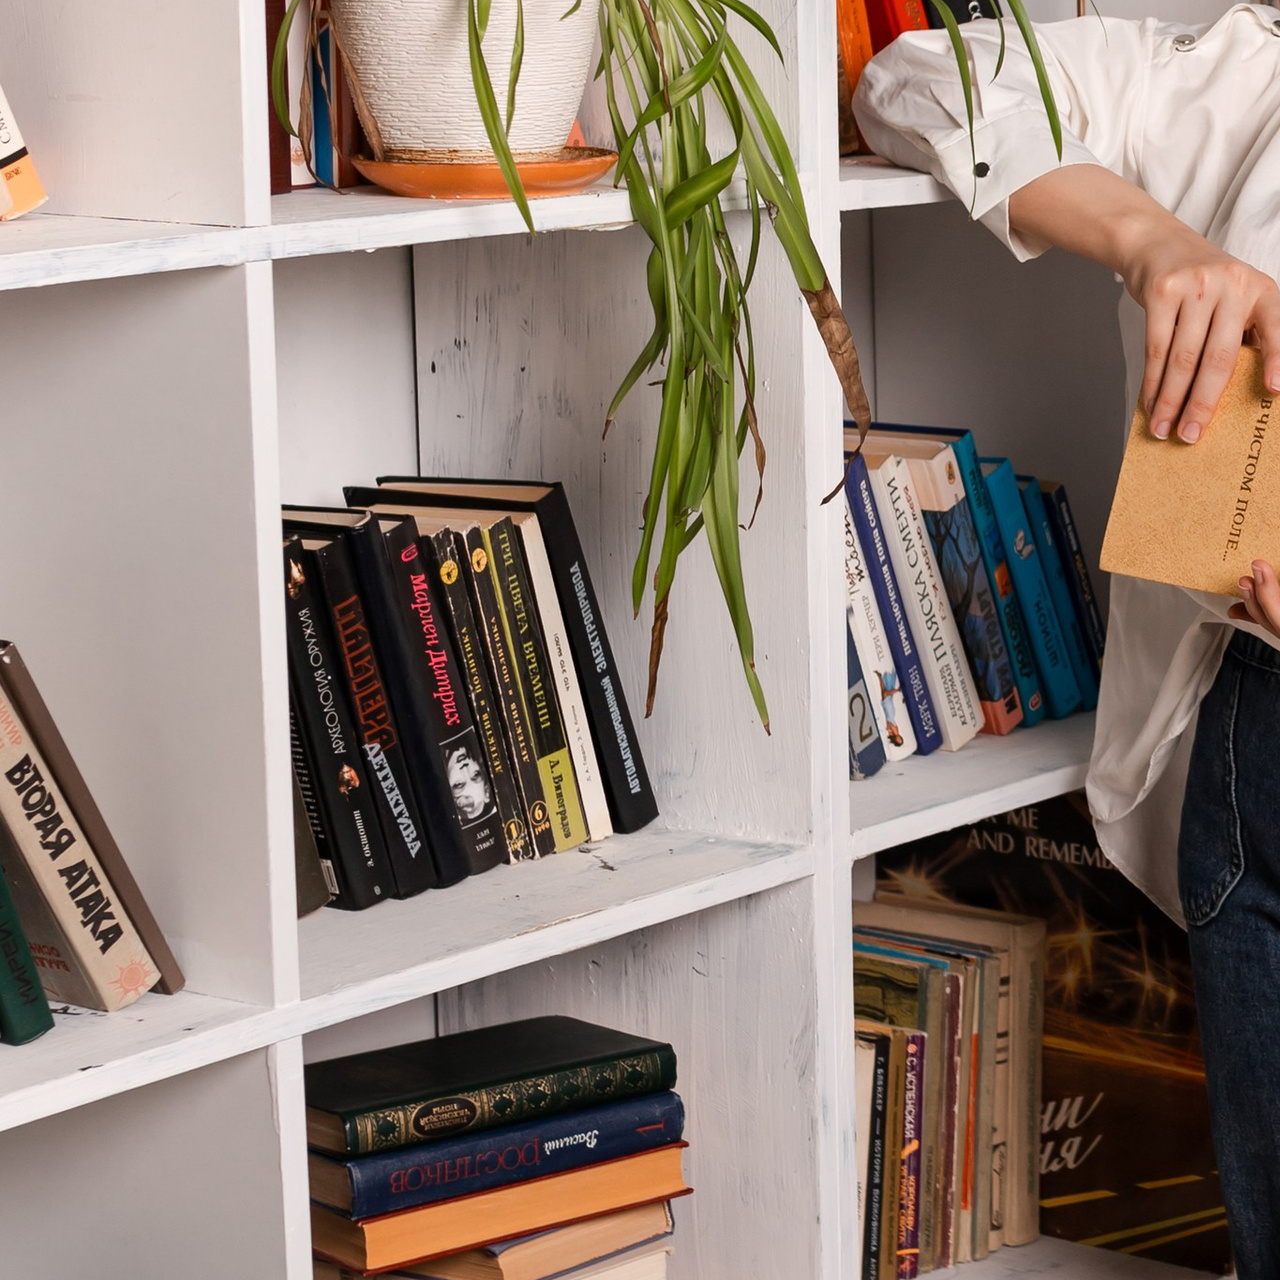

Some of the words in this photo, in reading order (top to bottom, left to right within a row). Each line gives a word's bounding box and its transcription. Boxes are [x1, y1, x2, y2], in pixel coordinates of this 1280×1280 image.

[1261, 398, 1272, 410] В
[1240, 413, 1270, 493] ЧИСТОМ
[887, 477, 919, 569] СМЕРТИ
[298, 607, 323, 667] ОРУЖИЯ
[409, 573, 440, 651] Марлен
[428, 647, 461, 727] Дитрих
[490, 615, 510, 683] ПОЛИТИКА
[498, 529, 514, 567] ТРИ
[508, 572, 529, 636] ЦВЕТА
[523, 639, 551, 731] ВРЕМЕНИ
[914, 570, 947, 663] ПЛЯСКА
[313, 667, 346, 755] АРХЕОЛОГИЯ
[509, 693, 530, 763] ДЕТЕКТИВ
[600, 675, 642, 795] АВТОМАТИЗИРОВАННЫЙ
[364, 742, 422, 859] ДЕТЕКТИВА
[966, 828, 1015, 855] AND
[5, 753, 77, 862] ВТОРАЯ
[58, 858, 124, 956] АТАКА
[542, 1128, 599, 1156] Василий
